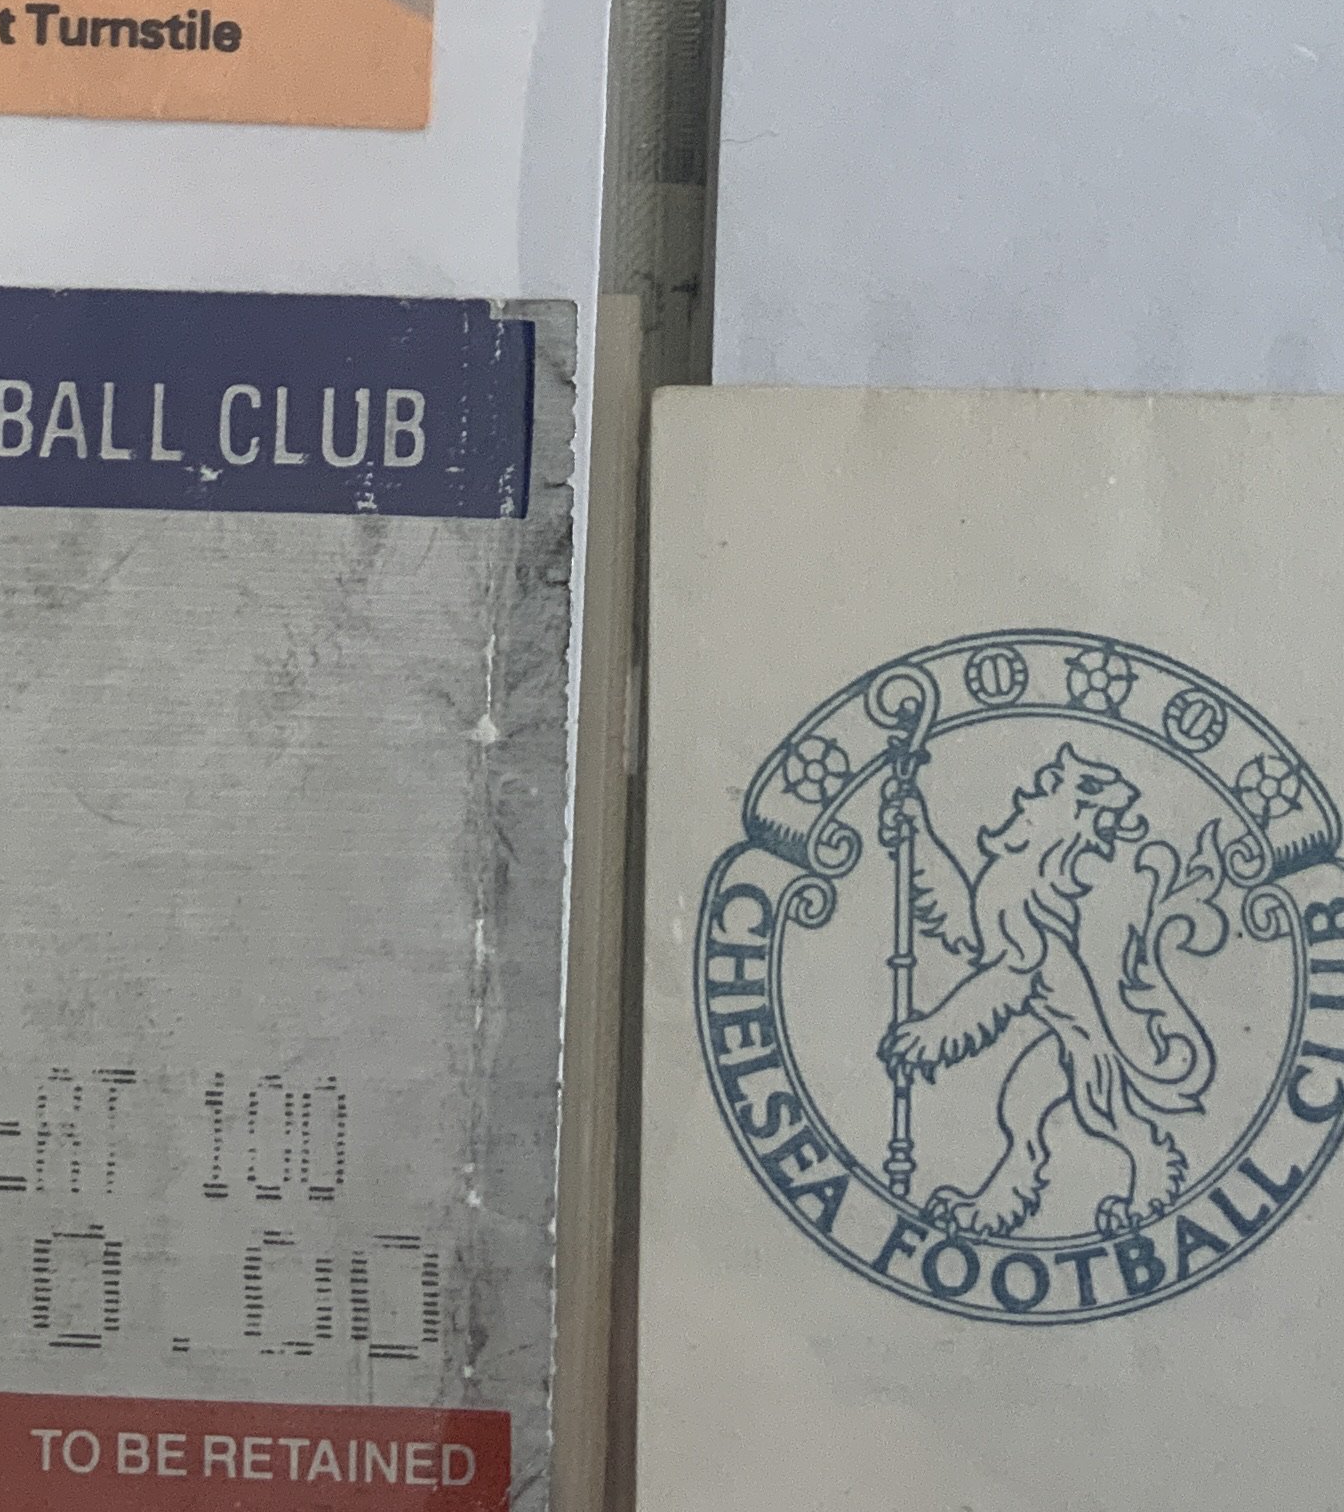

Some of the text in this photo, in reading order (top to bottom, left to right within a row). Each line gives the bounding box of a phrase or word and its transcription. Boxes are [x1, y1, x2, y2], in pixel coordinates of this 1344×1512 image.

[25, 3, 242, 54] Turnstile
[218, 383, 427, 469] CLUB
[204, 1072, 346, 1200] 100
[707, 883, 855, 1235] CHELSEA
[871, 1163, 1303, 1314] FOOTBALL
[30, 1428, 476, 1488] TO BE RETAINED
